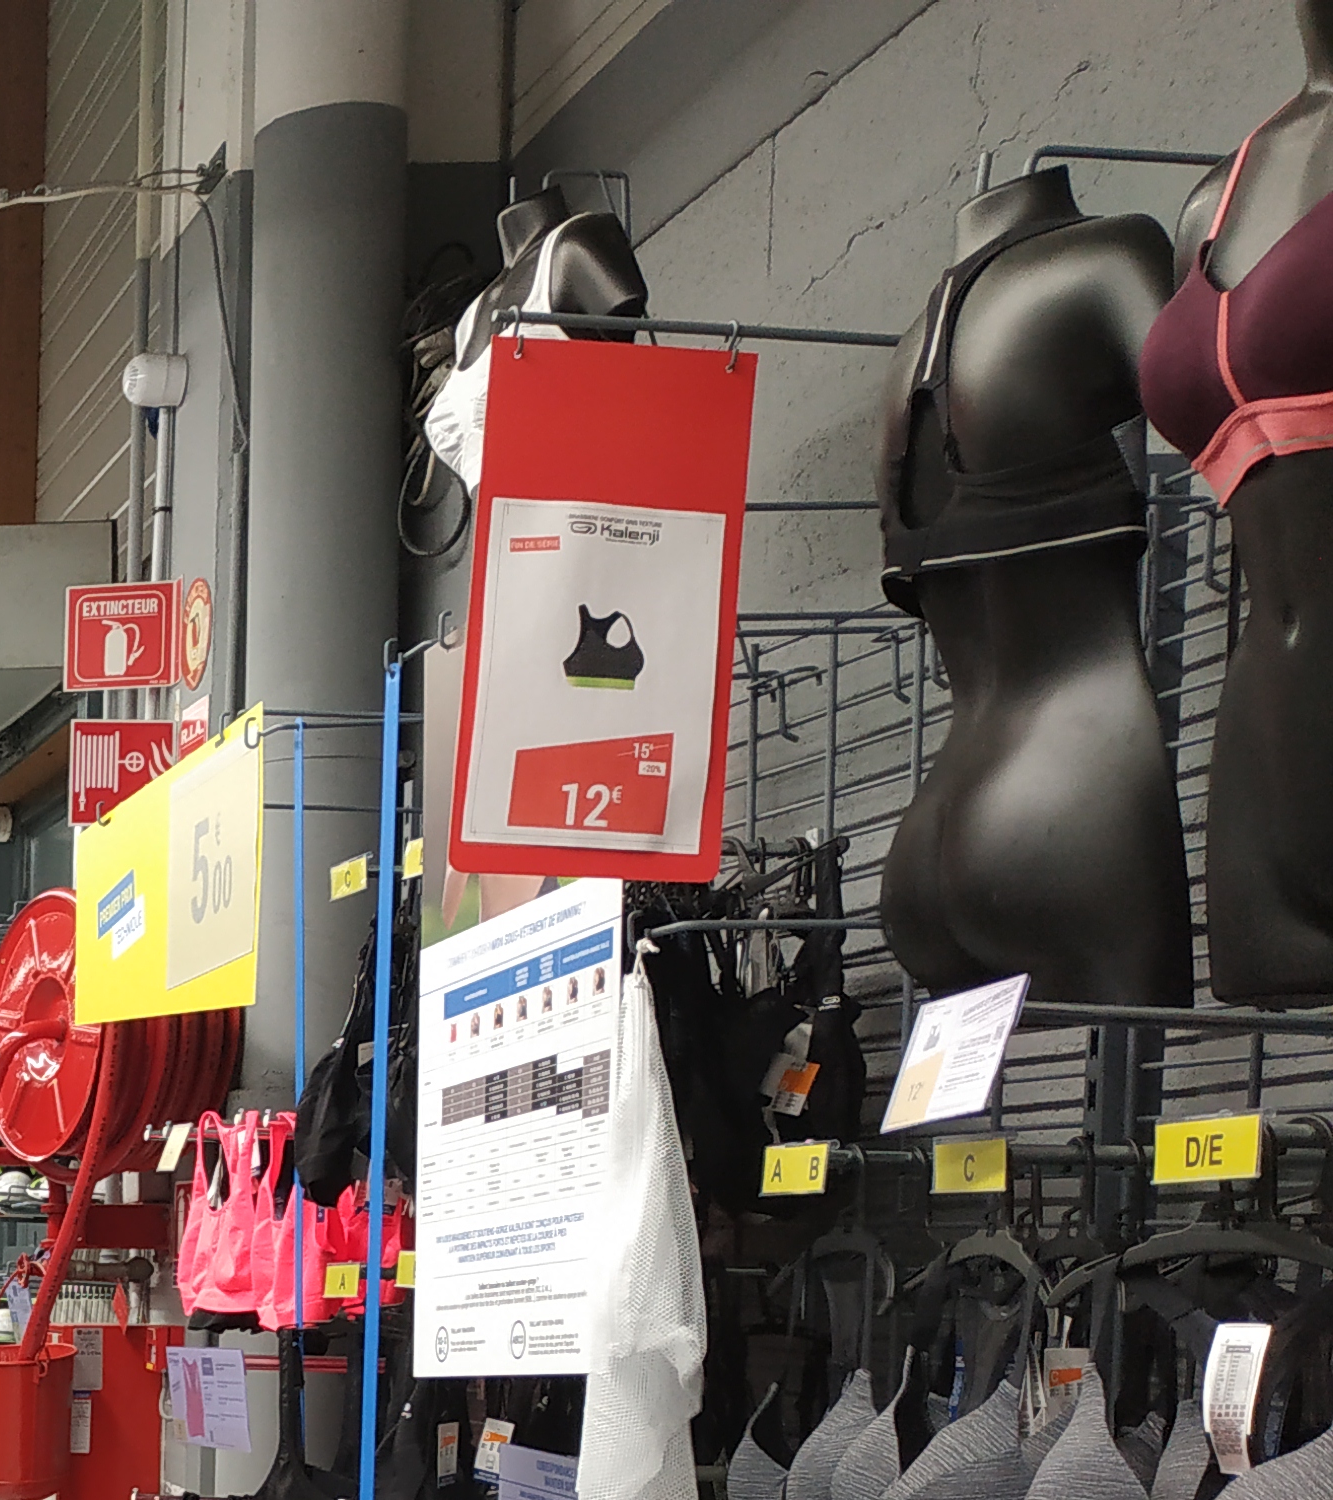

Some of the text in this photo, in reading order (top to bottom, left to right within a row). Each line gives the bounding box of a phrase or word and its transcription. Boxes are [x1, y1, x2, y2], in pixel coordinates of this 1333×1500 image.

[600, 523, 660, 546] Kalenji
[83, 598, 158, 617] EXTINCTEUR
[181, 722, 204, 745] R.I.A.
[560, 782, 623, 828] 12€
[1184, 1133, 1224, 1169] D/E
[770, 1156, 821, 1184] A B
[963, 1154, 977, 1183] C
